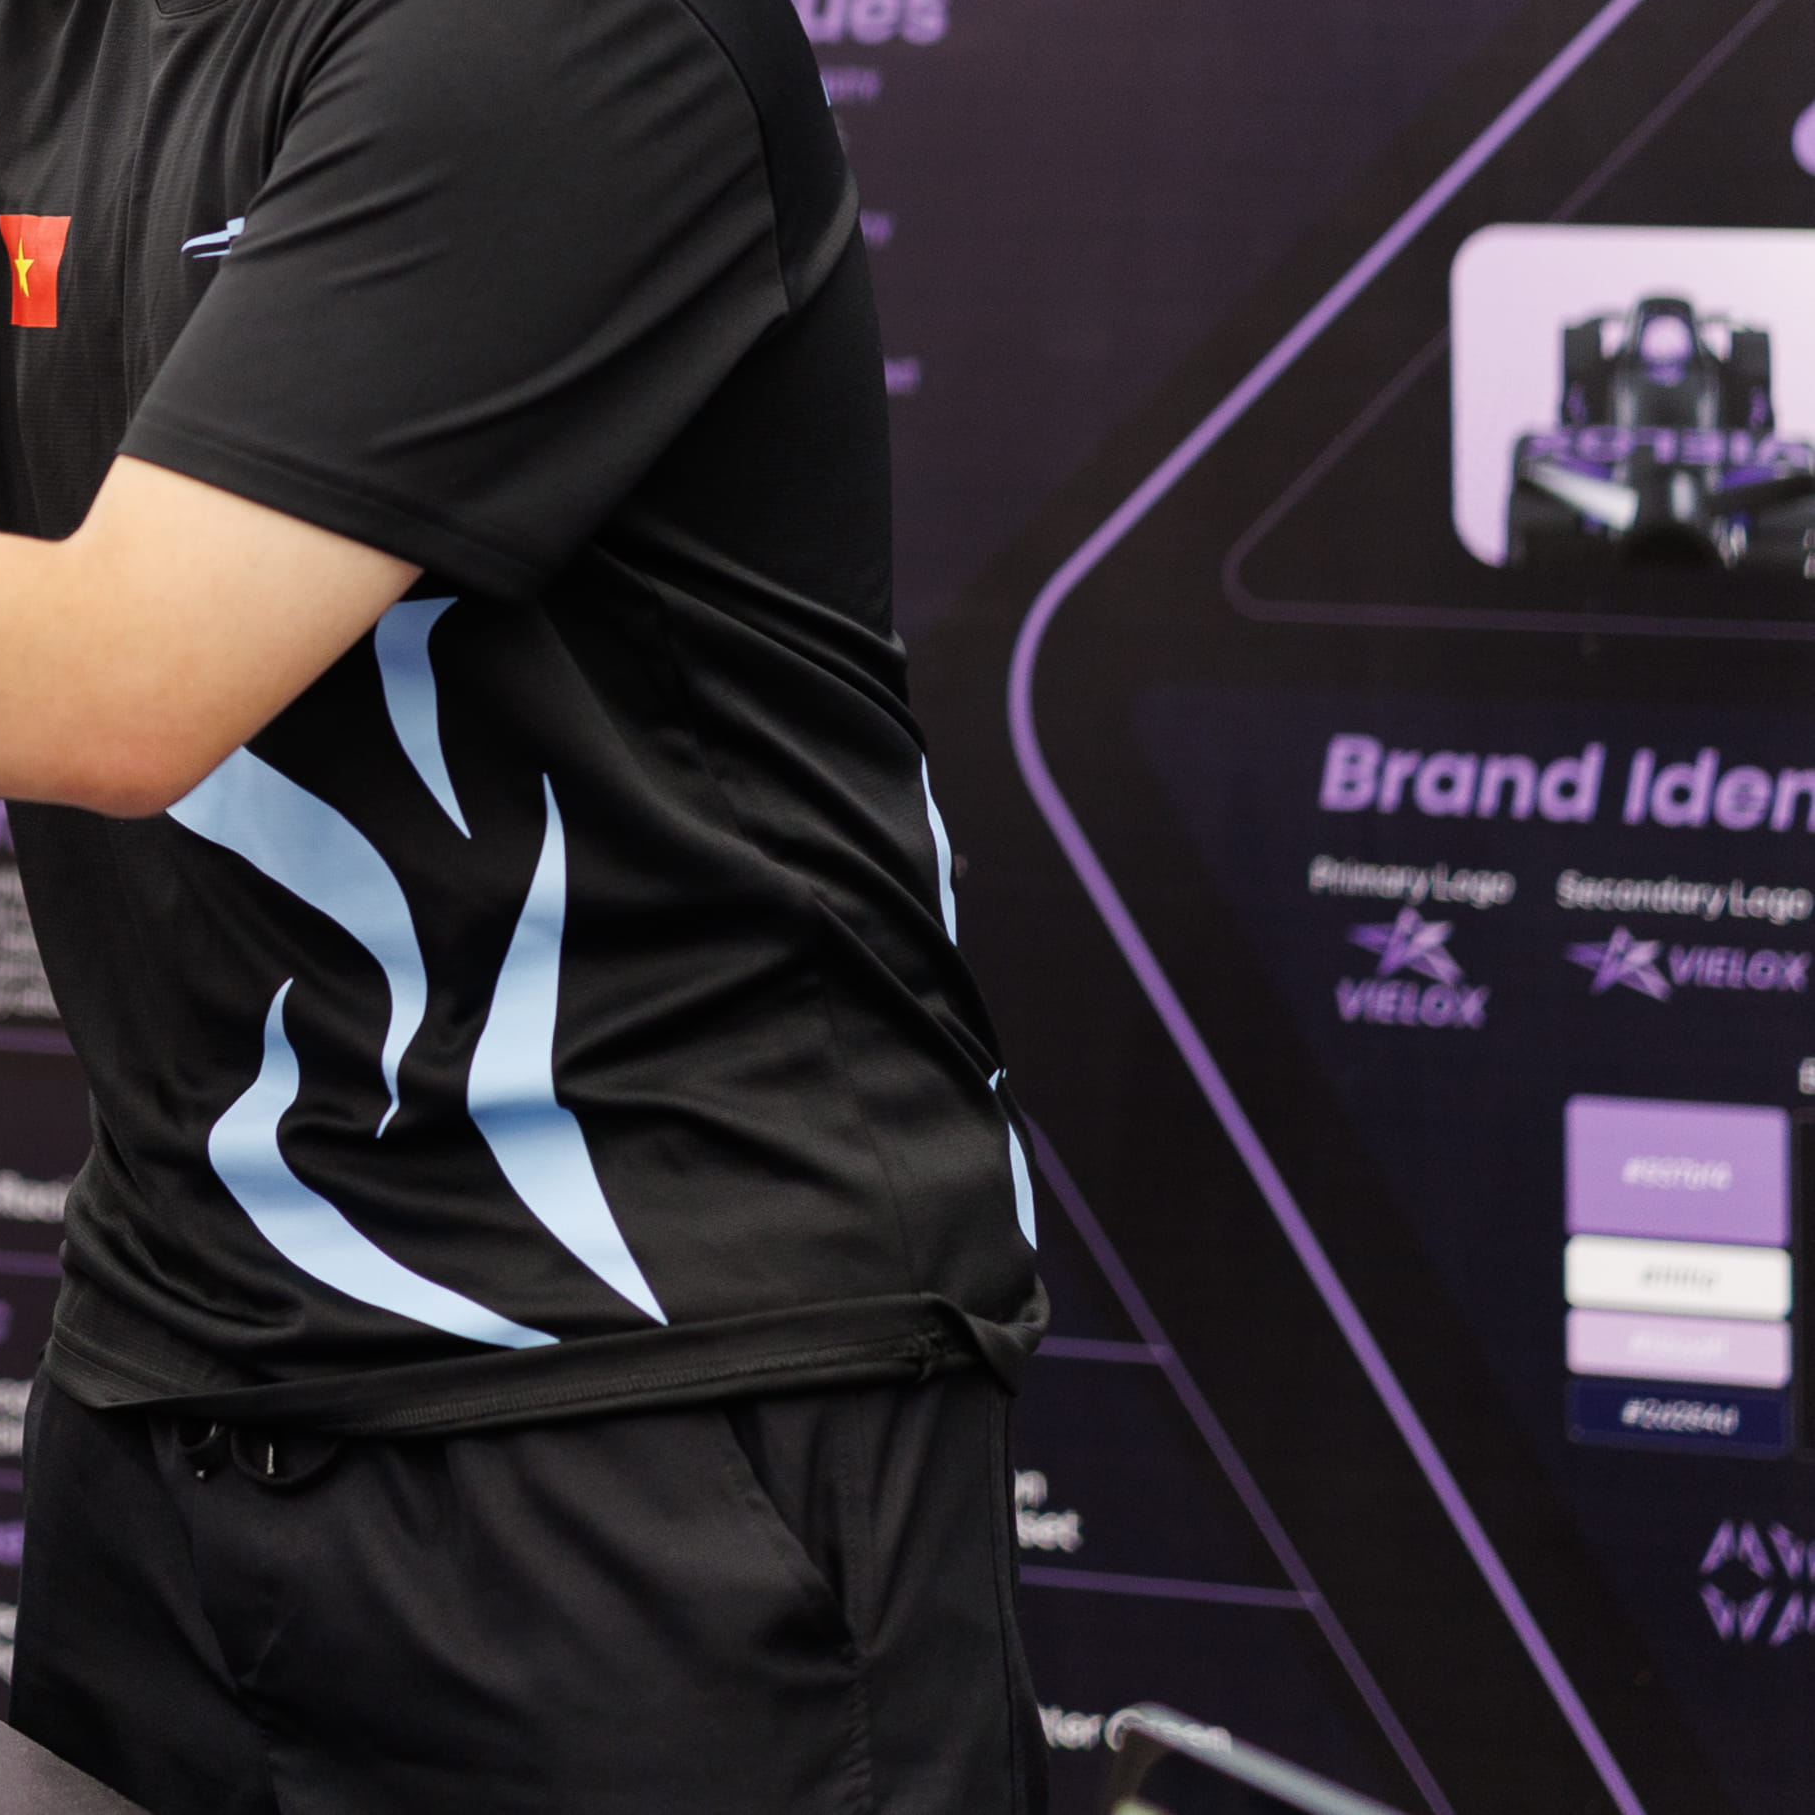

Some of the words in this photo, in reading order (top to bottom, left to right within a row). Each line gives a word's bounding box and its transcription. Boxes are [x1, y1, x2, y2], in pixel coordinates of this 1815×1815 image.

[1317, 732, 1608, 826] Brand
[1619, 746, 1815, 833] Iden
[1307, 855, 1433, 908] Primary
[1434, 862, 1518, 910] Logo
[1557, 869, 1728, 922] Secondary
[1728, 878, 1814, 926] Logo
[1668, 943, 1811, 993] VIELOX
[1333, 978, 1492, 1031] VIELOX
